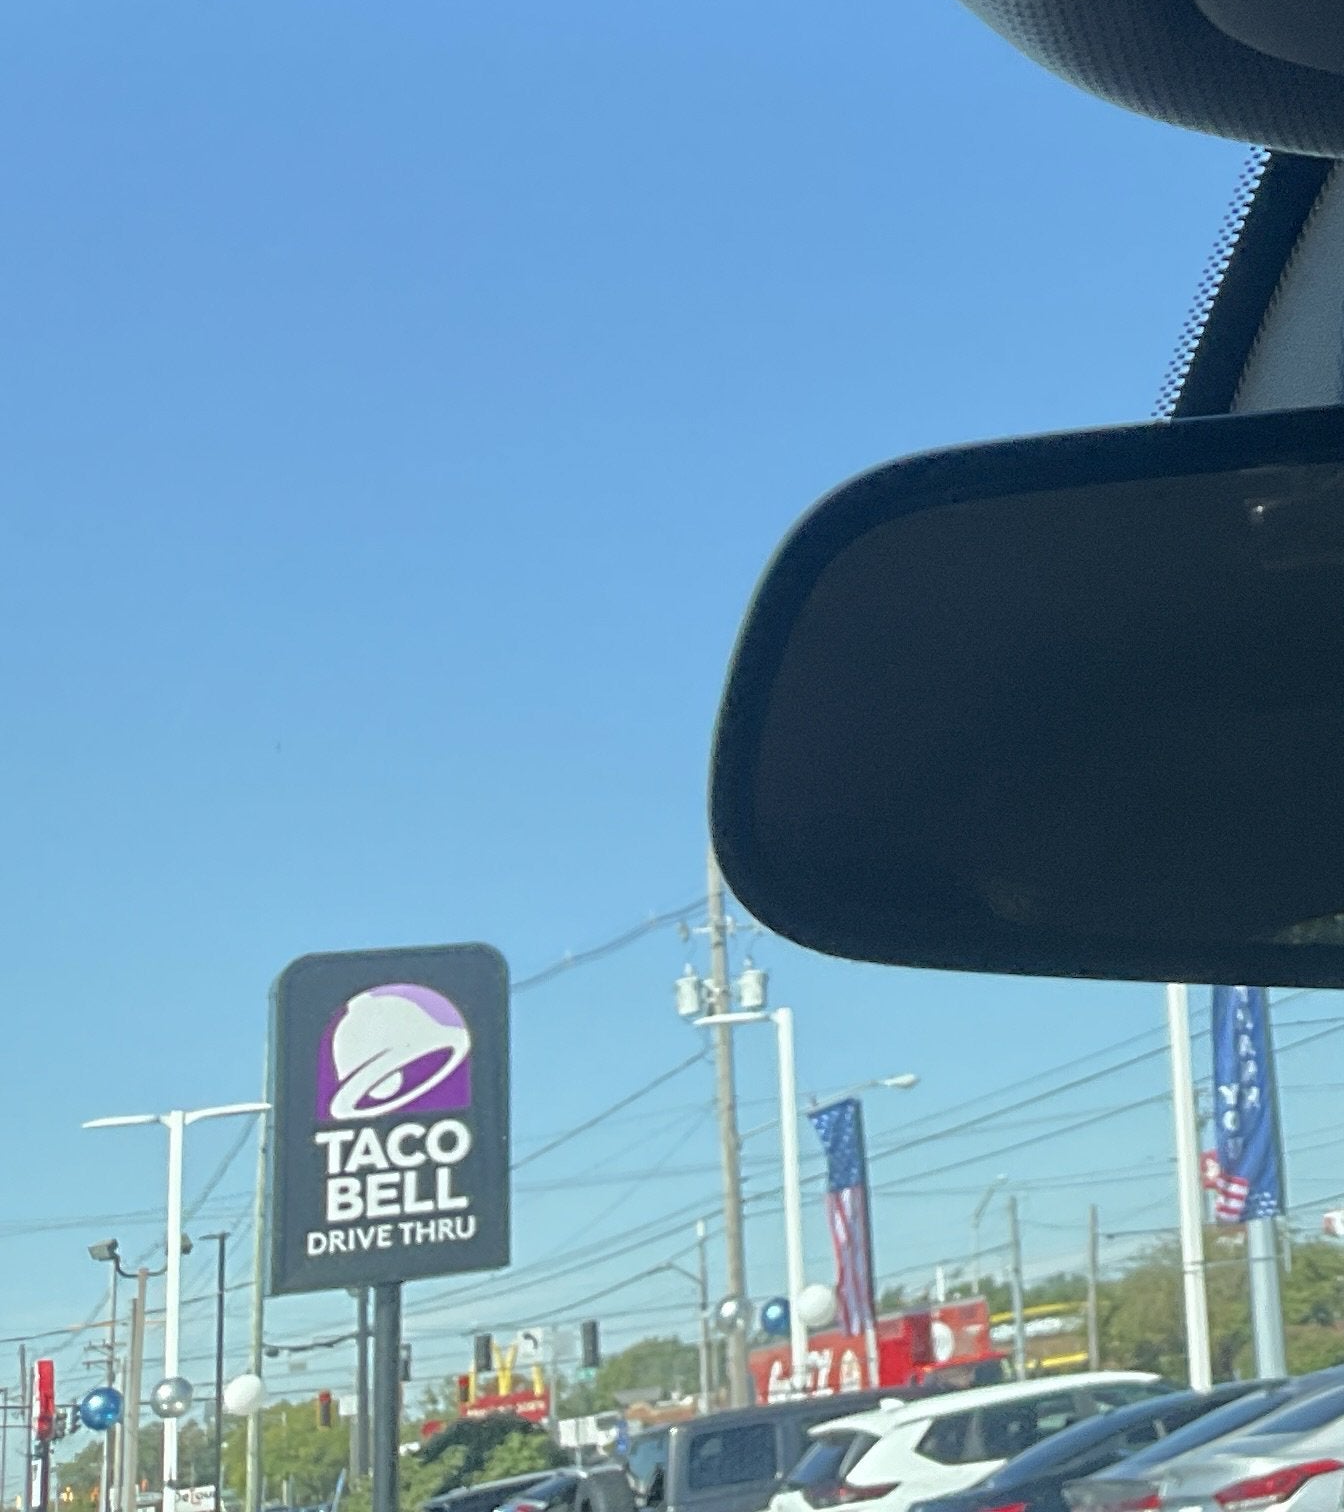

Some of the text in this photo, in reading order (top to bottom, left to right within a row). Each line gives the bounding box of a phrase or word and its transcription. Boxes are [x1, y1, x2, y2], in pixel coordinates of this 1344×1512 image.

[315, 1118, 472, 1174] TACO
[326, 1167, 469, 1223] BELL
[307, 1215, 477, 1256] DRIVE THRU
